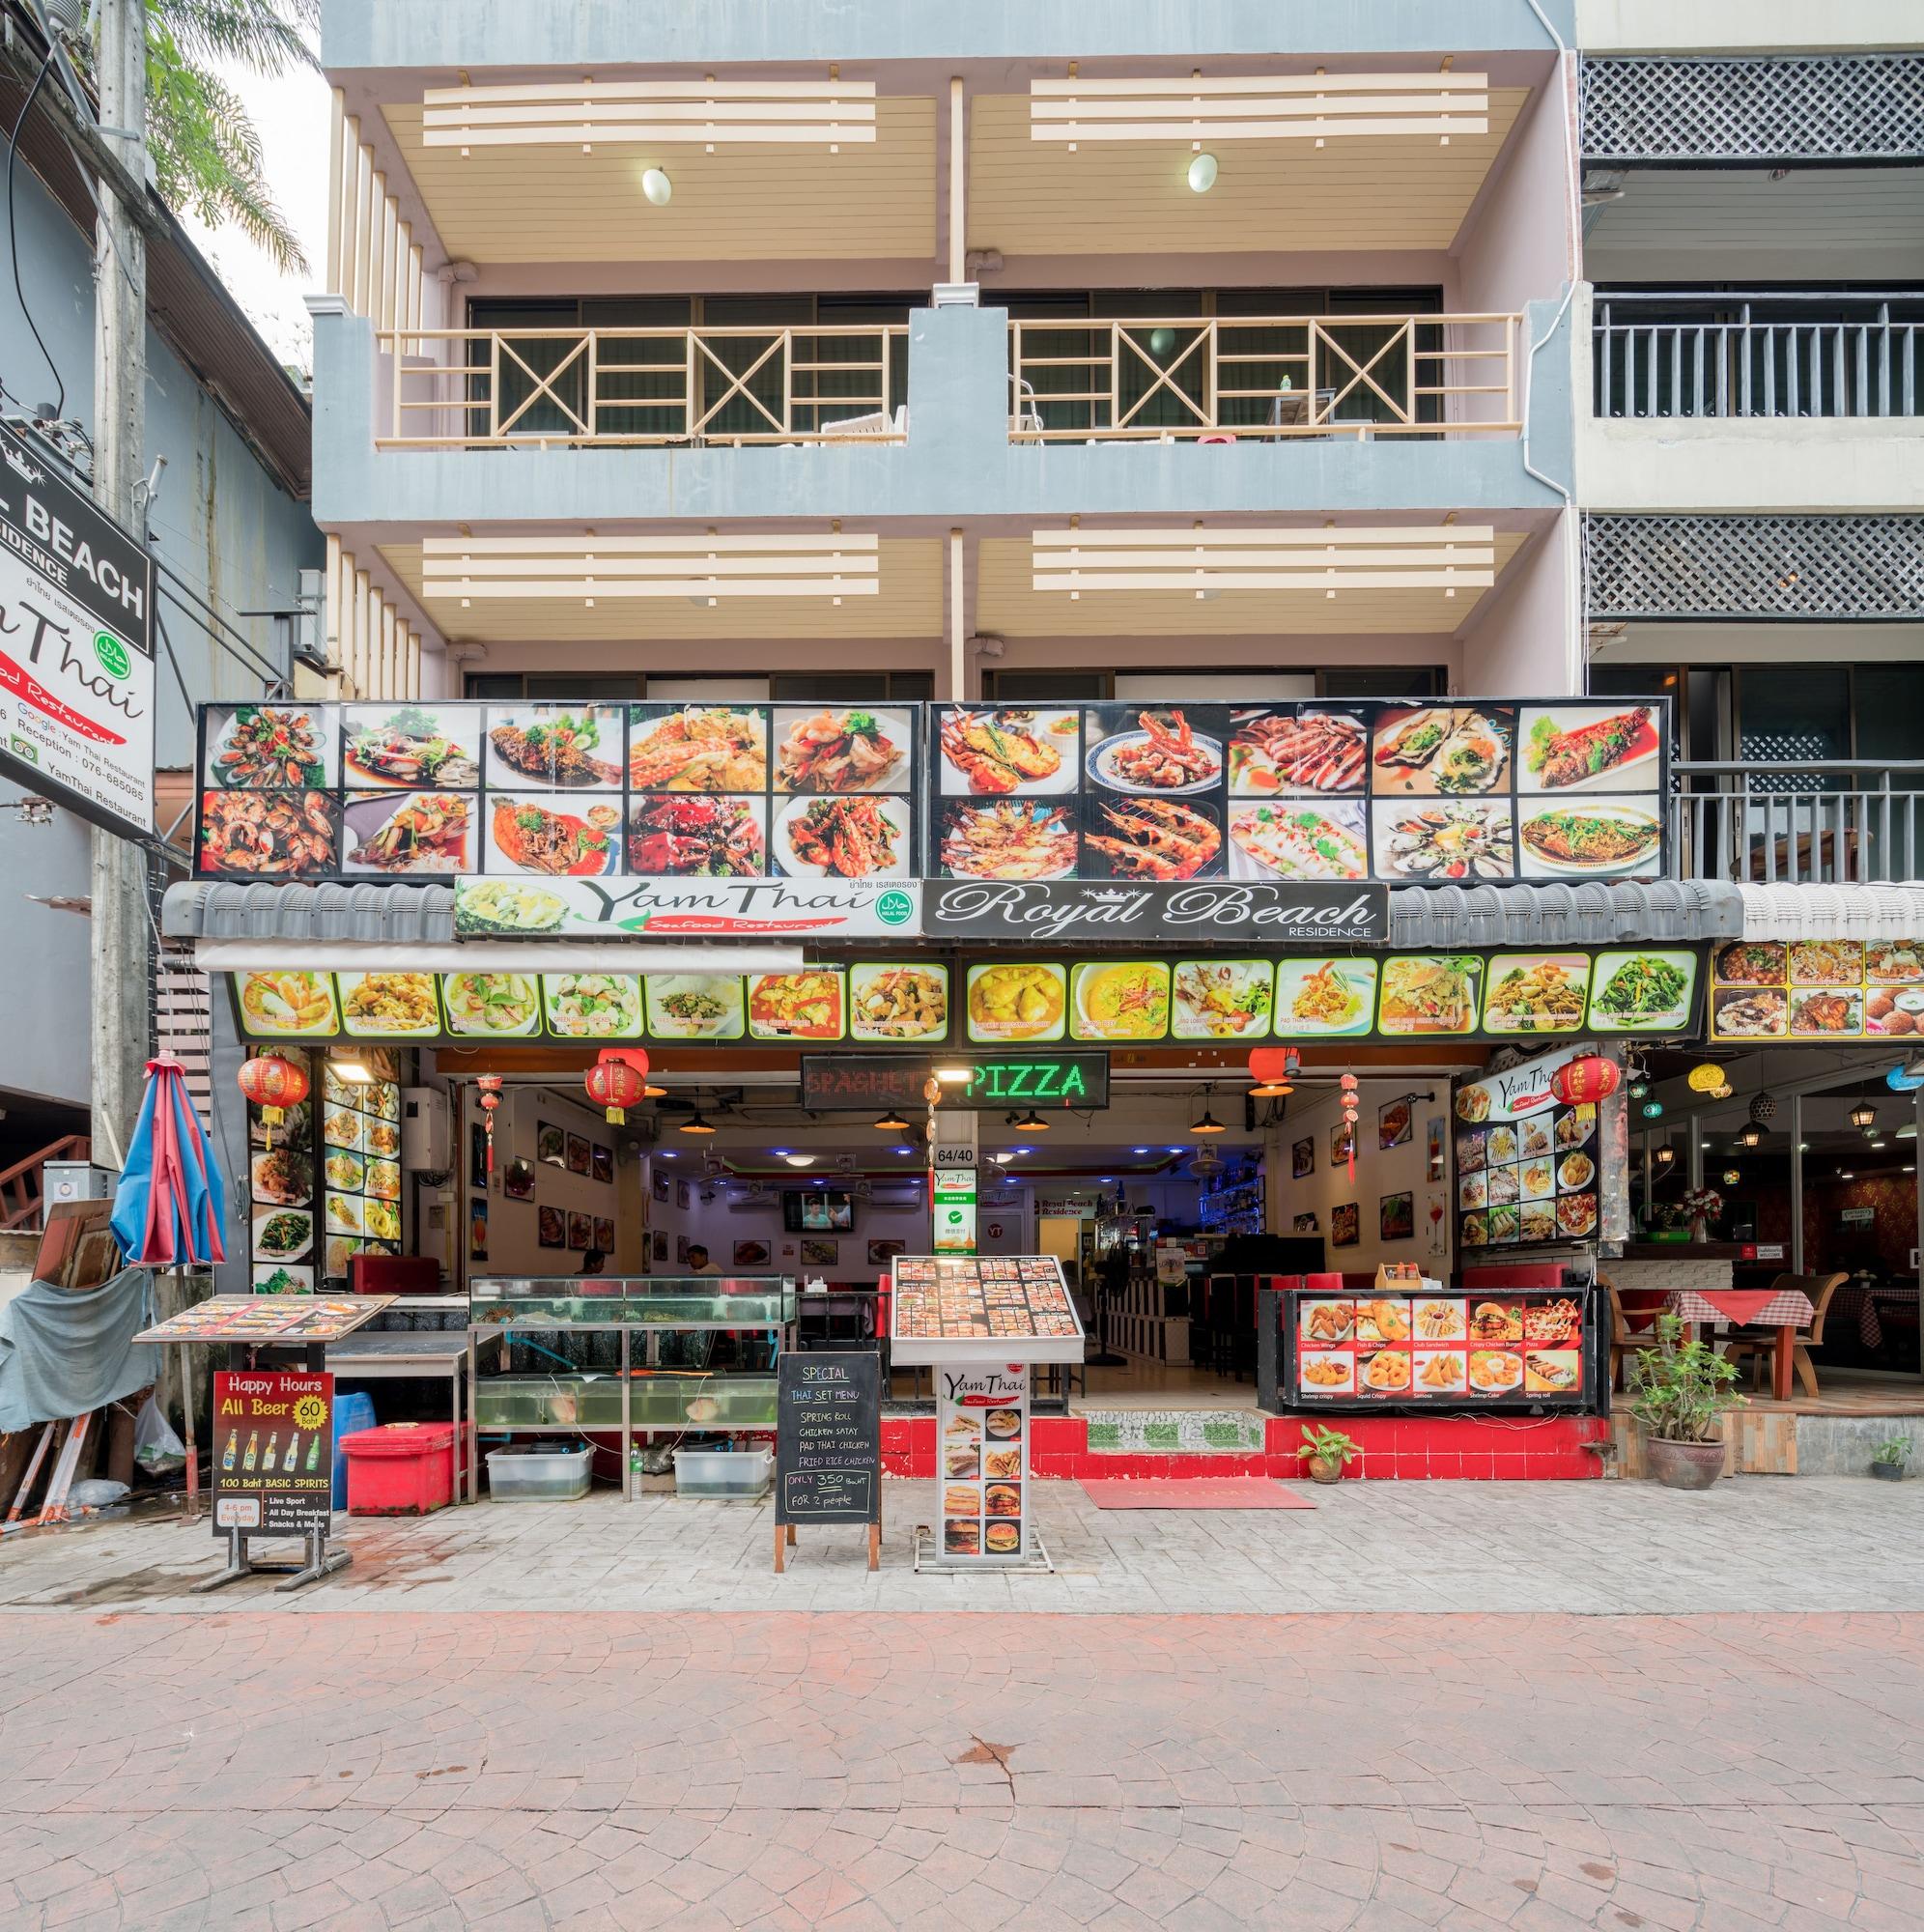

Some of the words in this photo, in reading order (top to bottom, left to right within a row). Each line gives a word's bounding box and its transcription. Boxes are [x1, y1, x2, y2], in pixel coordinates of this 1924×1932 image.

[0, 522, 68, 587] IDENCE
[26, 494, 143, 620] BEACH
[18, 600, 144, 719] Thai
[27, 682, 115, 746] Restaurant
[17, 701, 57, 734] Google
[62, 731, 81, 750] Yam
[84, 745, 101, 762] Thai
[103, 757, 146, 788] Restaurant
[17, 718, 71, 759] Reception
[82, 758, 144, 802] 076-685085
[96, 790, 147, 828] Restaurant
[578, 879, 729, 922] Yam
[727, 881, 875, 913] Thai
[934, 882, 1155, 938] Royal
[1162, 883, 1377, 925] Beach
[651, 920, 724, 930] Seafood
[1288, 926, 1372, 938] RESIDENCE
[967, 1065, 1086, 1097] PIZZA
[1498, 1075, 1530, 1108] Yam
[938, 1150, 973, 1162] 64/40
[802, 1366, 850, 1381] SPECIAL
[228, 1377, 273, 1395] Happy
[280, 1377, 323, 1392] Hours
[944, 1373, 987, 1400] Yam
[985, 1374, 1026, 1394] Thai
[791, 1390, 812, 1401] THAI
[815, 1390, 833, 1402] SET
[835, 1390, 860, 1400] MENU
[221, 1398, 243, 1415] All
[251, 1398, 290, 1415] Beer
[299, 1401, 321, 1417] 60
[800, 1411, 833, 1424] SPRING
[799, 1428, 834, 1438] CHICKEN
[835, 1428, 859, 1436] SATAY
[799, 1441, 814, 1453] PAD
[817, 1440, 836, 1450] THAI
[838, 1440, 870, 1450] CHICKEN
[799, 1457, 824, 1468] FRIED
[826, 1456, 842, 1465] RICE
[844, 1456, 876, 1466] CHICKEN
[220, 1478, 239, 1488] 100
[242, 1478, 262, 1488] Baht
[266, 1478, 291, 1488] BASIC
[295, 1479, 328, 1488] SPIRITS
[788, 1475, 813, 1486] ONLY
[817, 1474, 844, 1487] 350
[286, 1497, 305, 1506] Sport
[791, 1494, 810, 1507] FOR
[813, 1495, 821, 1506] 2
[823, 1494, 853, 1509] people
[221, 1514, 256, 1523] Eveyday
[280, 1509, 295, 1519] Day
